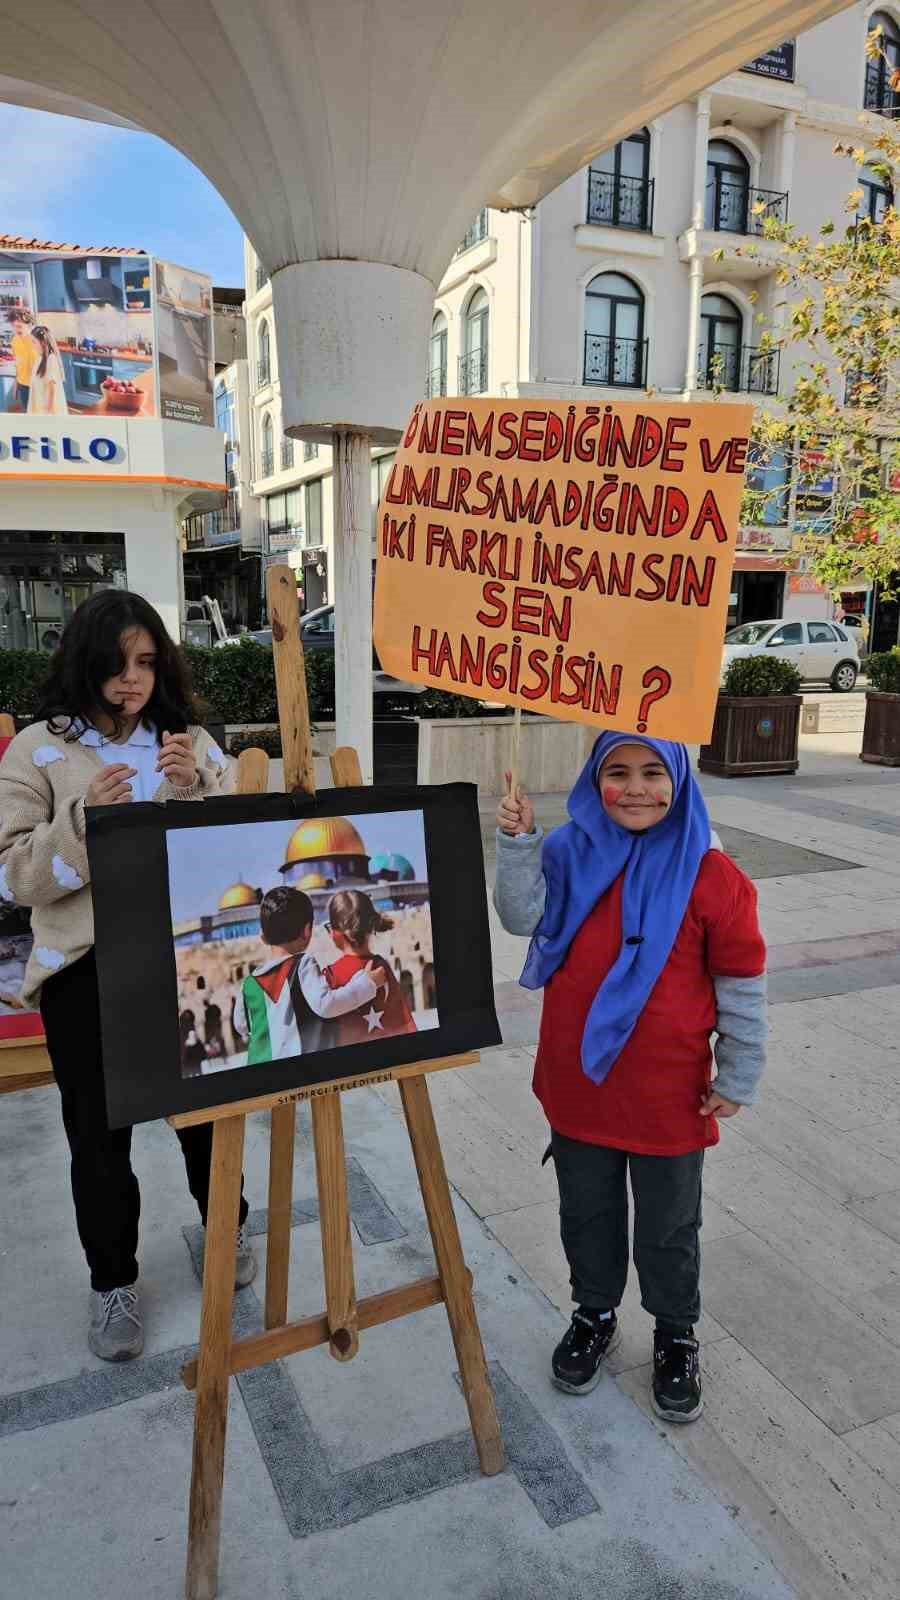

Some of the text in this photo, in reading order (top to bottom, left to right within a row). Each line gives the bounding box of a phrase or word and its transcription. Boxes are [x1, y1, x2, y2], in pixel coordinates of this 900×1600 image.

[0, 436, 117, 462] FiLO
[700, 437, 749, 473] VE
[382, 512, 717, 607] İKİ FARKLI İNSANSIN
[476, 581, 573, 642] SEN
[411, 624, 672, 733] HANGİSİSİN ?
